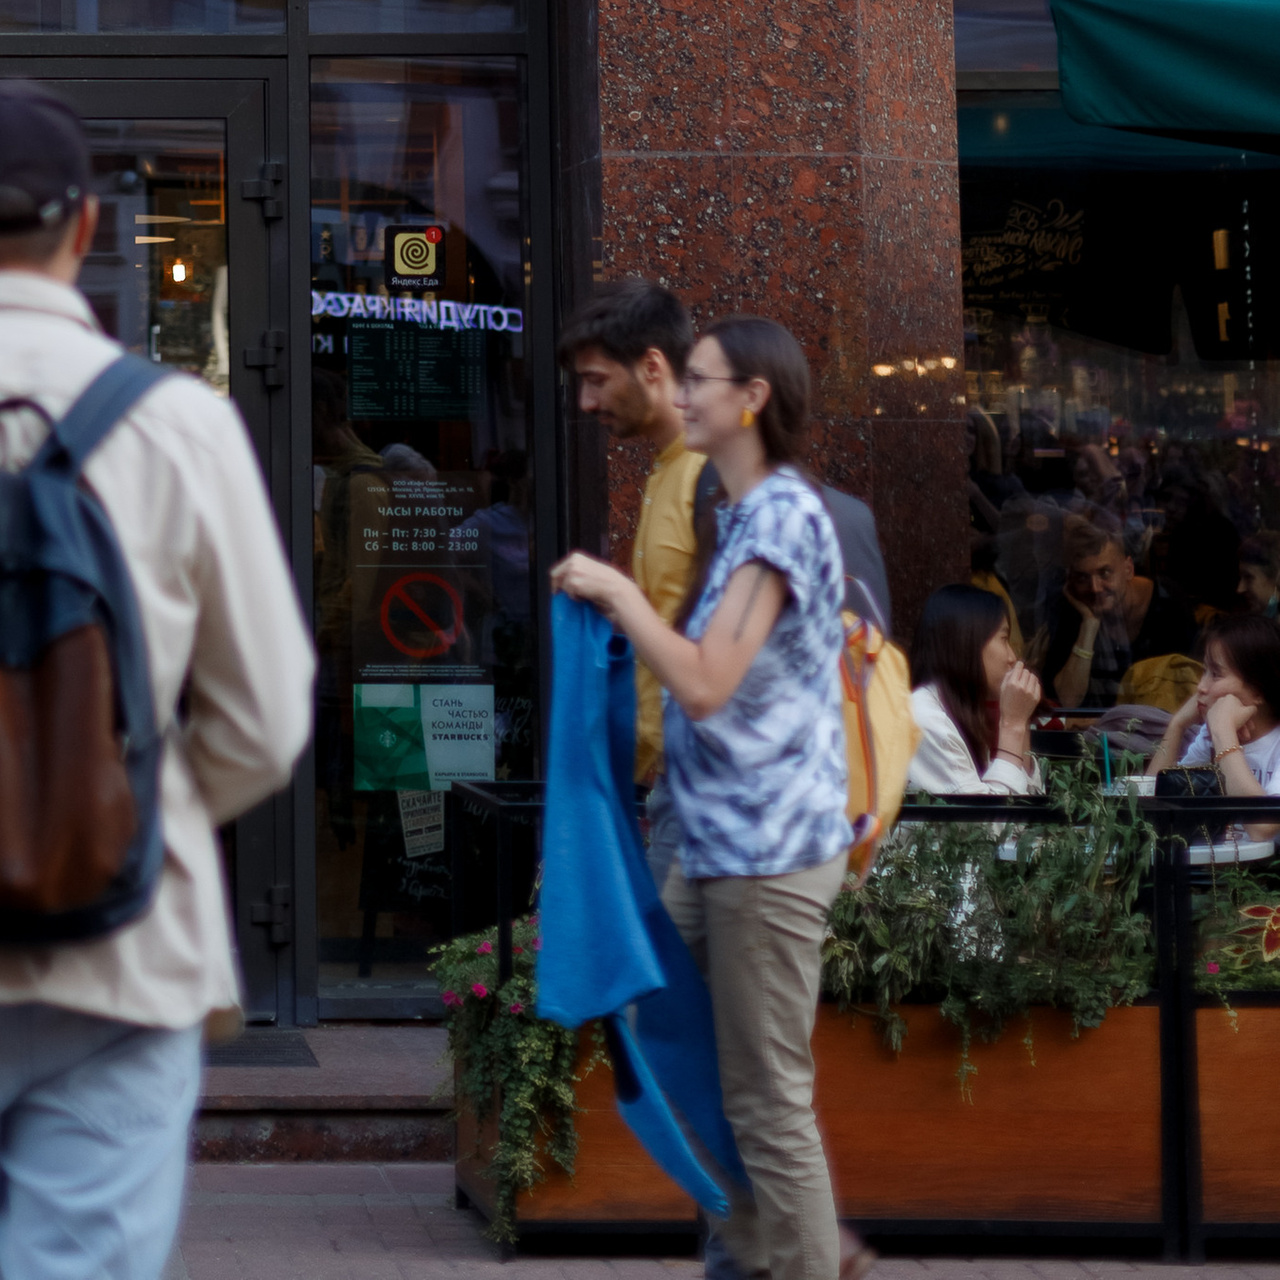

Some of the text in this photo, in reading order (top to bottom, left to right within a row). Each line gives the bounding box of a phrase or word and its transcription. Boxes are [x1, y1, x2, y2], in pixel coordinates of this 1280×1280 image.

[377, 507, 463, 517] ЧАСЫ РАБОТЫ
[363, 528, 379, 538] Пн
[392, 528, 409, 538] Пт:
[412, 528, 436, 538] 7:30
[448, 528, 479, 538] 23:00
[364, 541, 379, 551] Сб
[392, 541, 408, 551] Вс:
[411, 541, 435, 551] 8:00
[448, 541, 478, 551] 23:00
[432, 698, 463, 708] СТАНЬ
[448, 710, 489, 719] ЧАСТЬЮ
[431, 721, 483, 730] КОМАНДЫ
[432, 733, 489, 741] STARBUCKS
[401, 791, 442, 811] СКАЧАЙТЕ
